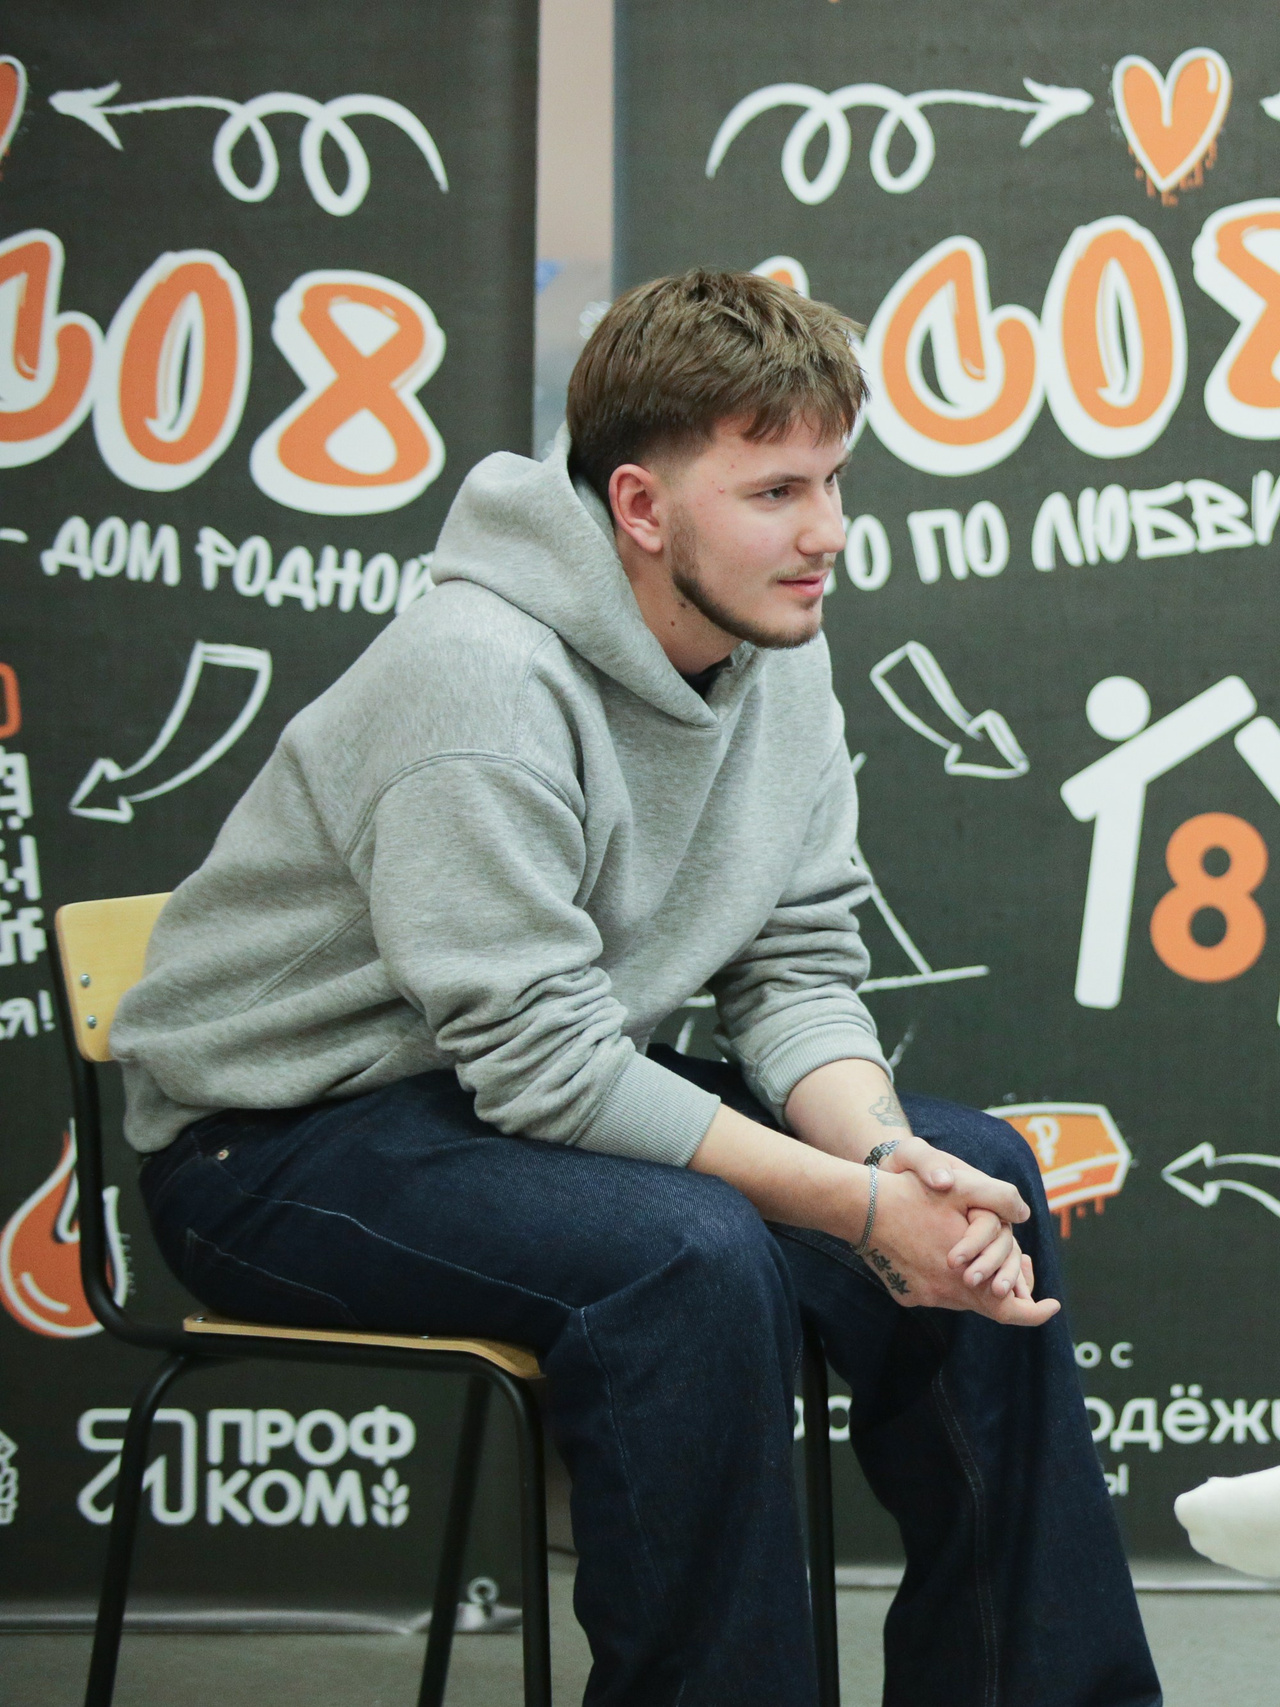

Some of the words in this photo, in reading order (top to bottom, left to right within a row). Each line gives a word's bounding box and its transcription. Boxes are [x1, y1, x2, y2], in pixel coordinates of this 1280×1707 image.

[40, 515, 181, 588] ДОМ
[907, 500, 1010, 585] ПО
[207, 1405, 416, 1466] ПРОФ
[207, 1469, 366, 1526] КОМ
